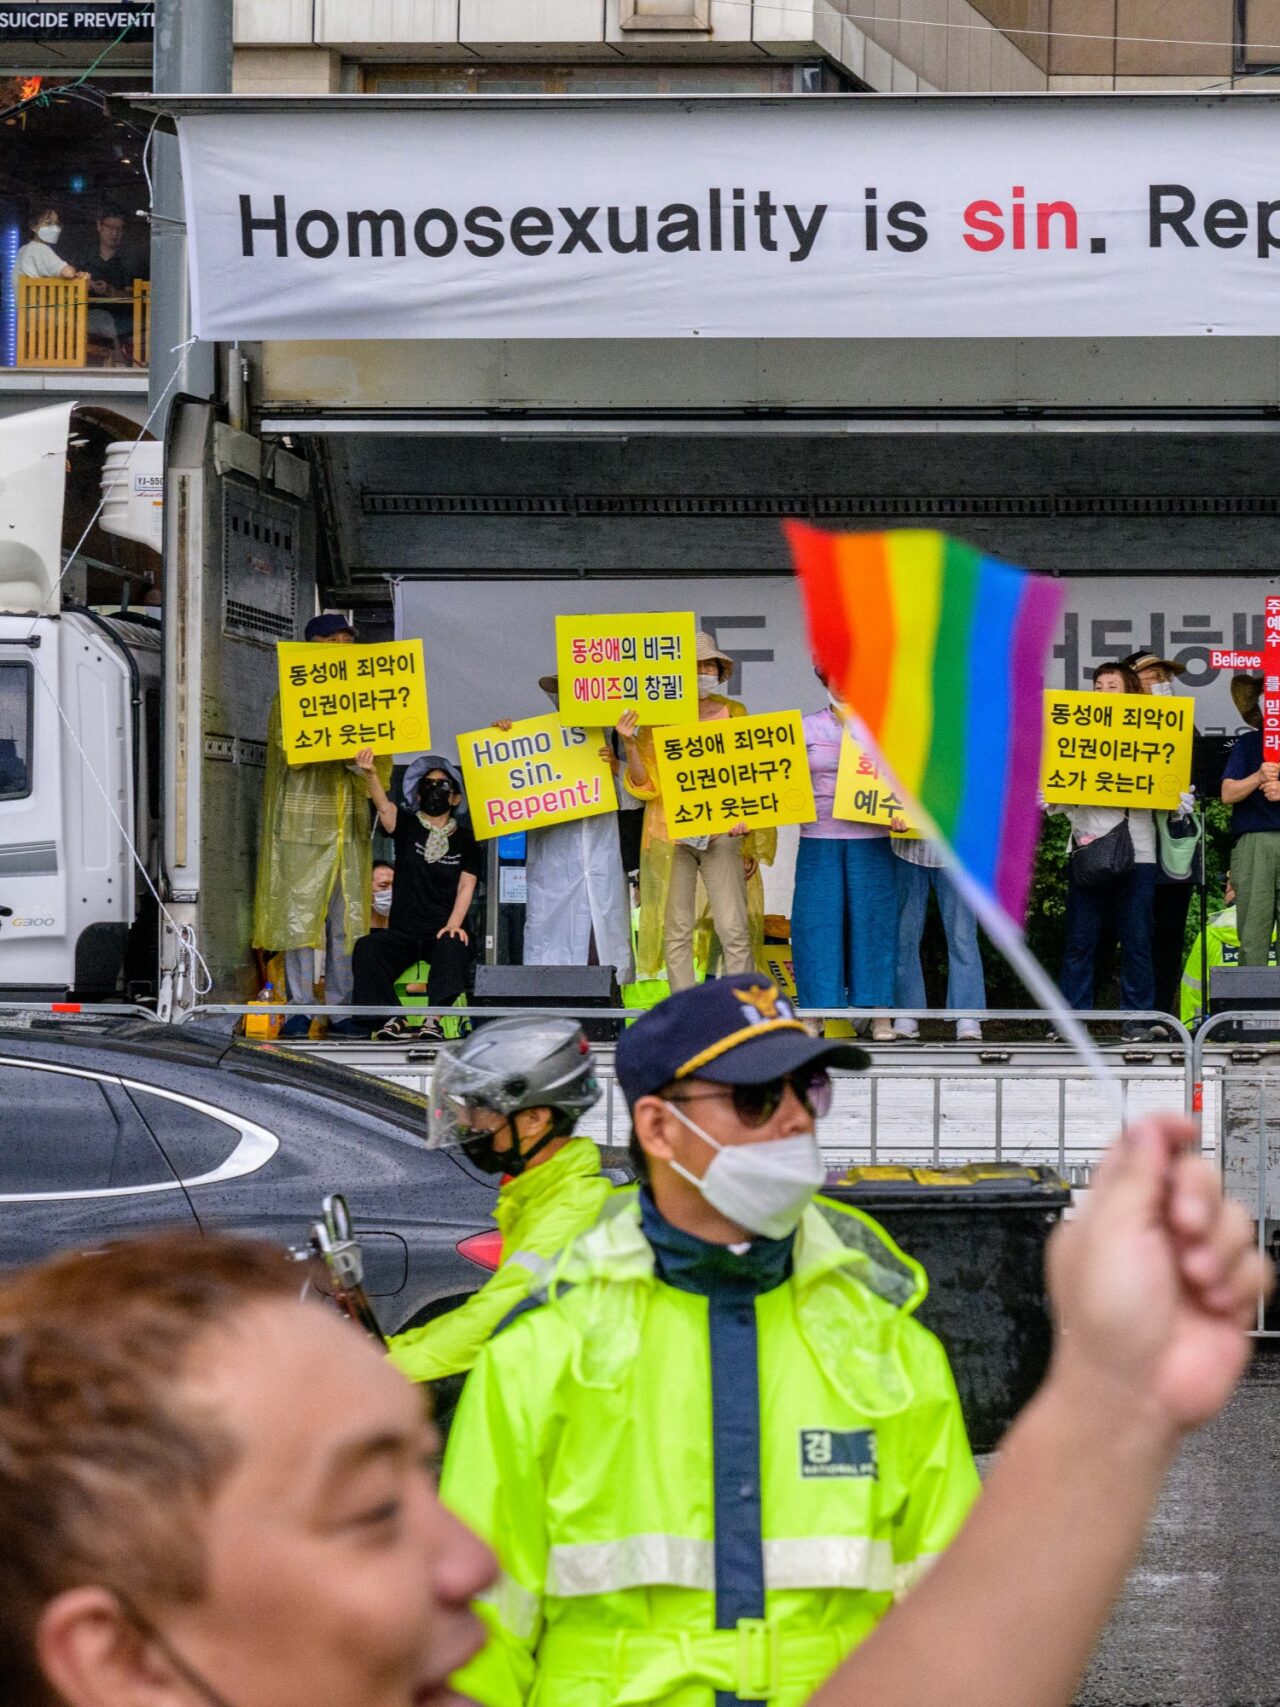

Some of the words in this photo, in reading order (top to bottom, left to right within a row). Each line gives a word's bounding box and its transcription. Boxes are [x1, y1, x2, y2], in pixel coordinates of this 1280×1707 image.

[0, 12, 69, 28] SUICIDE
[238, 187, 827, 261] Homosexuality
[865, 187, 927, 252] is
[963, 187, 1107, 253] sin.
[572, 637, 637, 664] 동성애의
[643, 636, 682, 661] 비극!
[1212, 651, 1262, 667] Believe
[289, 660, 348, 686] 동성애
[356, 652, 415, 678] 죄악이
[299, 686, 410, 718] 인권이라구?
[573, 676, 639, 701] 에이즈의
[645, 675, 683, 701] 창궐!
[1051, 703, 1113, 728] 동성애
[1122, 707, 1184, 732] 죄악이
[294, 727, 332, 749] 소가
[339, 720, 396, 745] 웃는다
[472, 732, 551, 768] Homo
[561, 726, 587, 747] is
[663, 732, 725, 761] 동성애
[734, 723, 795, 751] 죄악이
[1057, 737, 1176, 764] 인권이라구?
[509, 761, 562, 789] sin.
[676, 758, 792, 793] 인권이라구?
[1046, 769, 1087, 792] 소가
[1094, 771, 1155, 795] 웃는다
[486, 777, 600, 826] Repent!
[674, 801, 712, 824] 소가
[720, 792, 779, 819] 웃는다
[11, 917, 56, 927] G300
